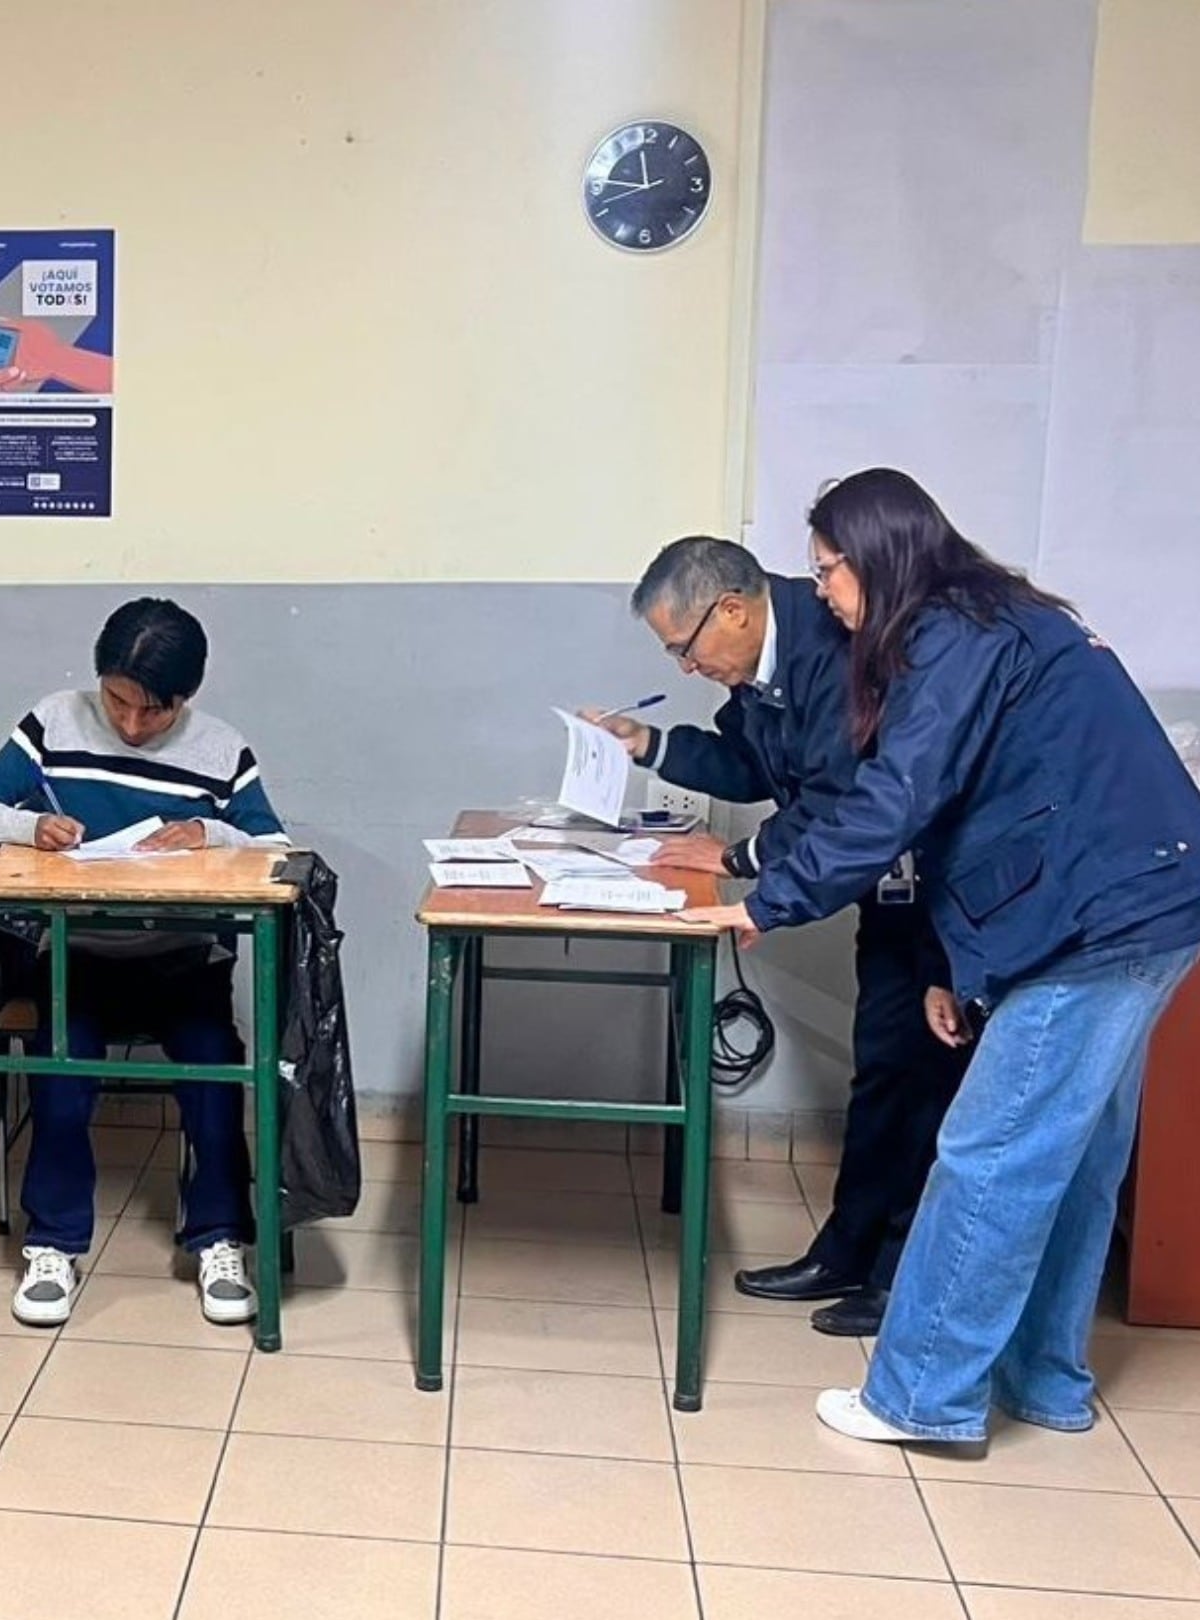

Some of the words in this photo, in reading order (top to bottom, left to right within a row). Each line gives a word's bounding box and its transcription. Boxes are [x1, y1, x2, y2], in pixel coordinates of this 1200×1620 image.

[690, 177, 704, 193] 3
[639, 228, 651, 244] 6
[30, 282, 93, 293] VOTAMOS
